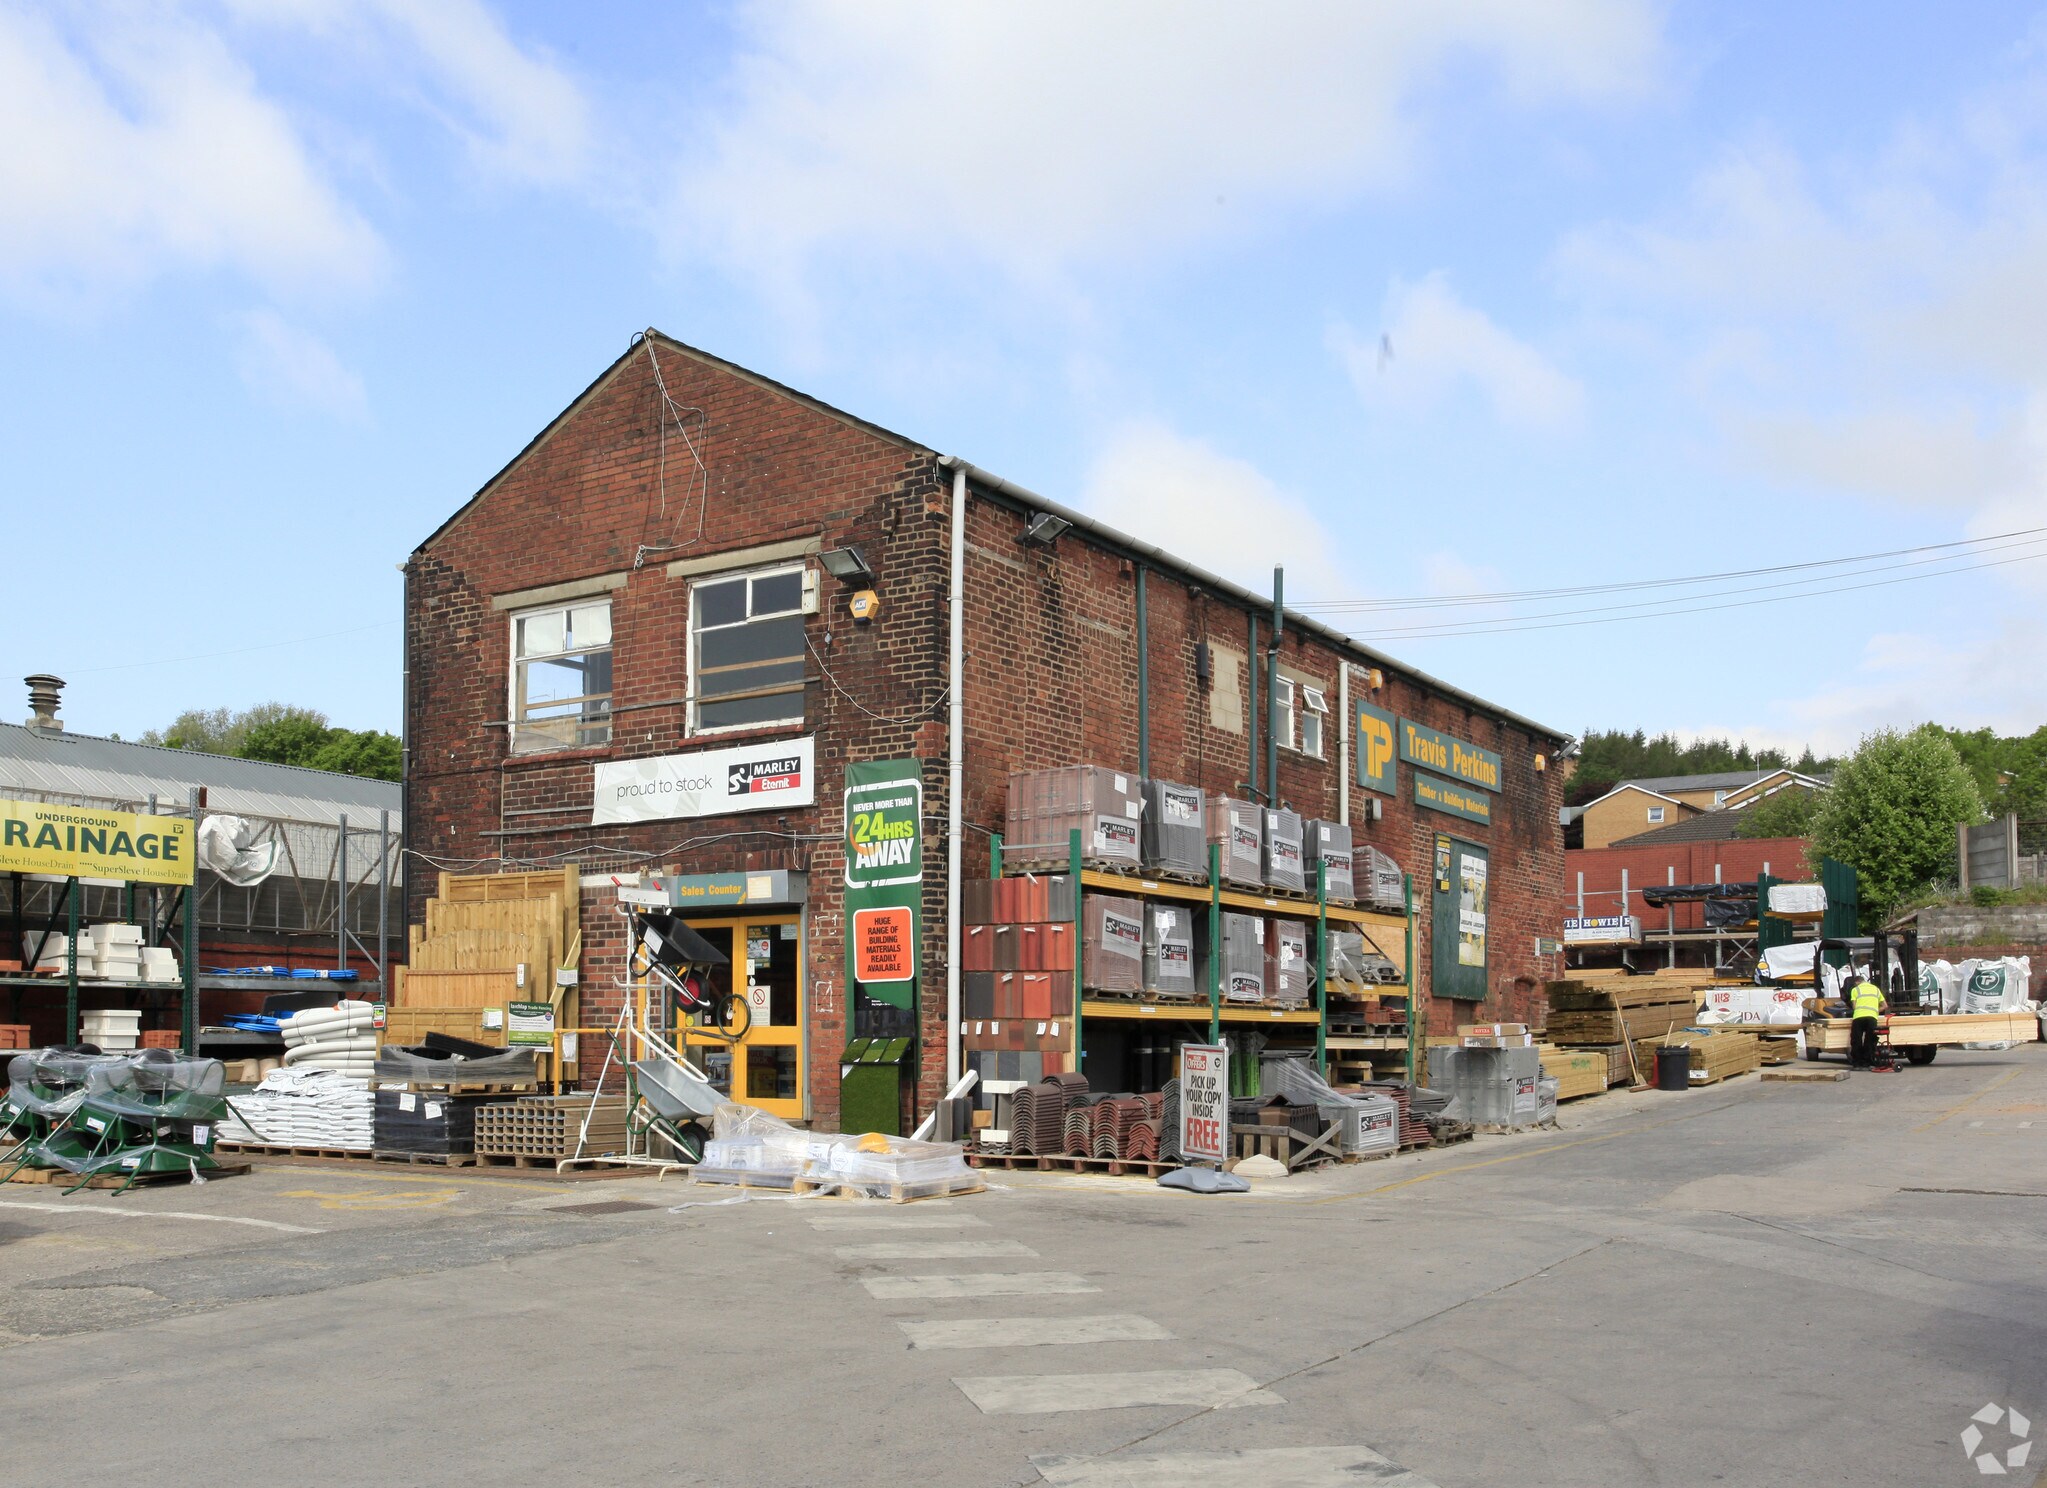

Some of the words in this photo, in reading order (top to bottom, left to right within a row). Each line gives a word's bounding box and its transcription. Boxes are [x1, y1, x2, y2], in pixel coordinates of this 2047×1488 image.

[1361, 712, 1393, 779] TP
[1407, 726, 1447, 769] Travis
[1453, 743, 1497, 785] Perkins
[754, 759, 798, 776] MARLEY
[617, 780, 656, 801] proud
[658, 779, 672, 793] to
[675, 774, 712, 791] stock
[761, 778, 790, 791] Eternit
[853, 802, 874, 812] NEVER
[875, 799, 894, 809] MORE
[895, 797, 913, 807] THAN
[1418, 782, 1436, 800] Timber
[1444, 791, 1464, 811] Building
[1466, 798, 1489, 816] Materials
[35, 812, 118, 828] UNDERGROUND
[854, 811, 914, 843] 24HRS
[1112, 824, 1135, 835] MARLEY
[4, 819, 179, 861] RAINAGE
[855, 838, 915, 869] AWAY
[22, 857, 74, 870] HouseDrain
[93, 863, 141, 876] SuperSleve
[142, 868, 189, 879] HouseDrain
[681, 885, 705, 896] Sales
[708, 884, 742, 895] Counter
[874, 917, 891, 925] HUGE
[1120, 922, 1140, 933] MARLEY
[867, 926, 889, 935] RANGE
[890, 926, 898, 934] OF
[869, 936, 898, 945] BUILDING
[866, 944, 901, 954] MATERIALS
[871, 954, 897, 963] READILY
[867, 963, 901, 972] AVAILABLE
[1980, 975, 1997, 986] TP
[1191, 1075, 1205, 1089] PICK
[1206, 1076, 1216, 1090] UP
[1185, 1089, 1202, 1103] YOUR
[1204, 1091, 1221, 1105] COPY
[1192, 1104, 1214, 1118] INSIDE
[1186, 1118, 1219, 1151] FREE
